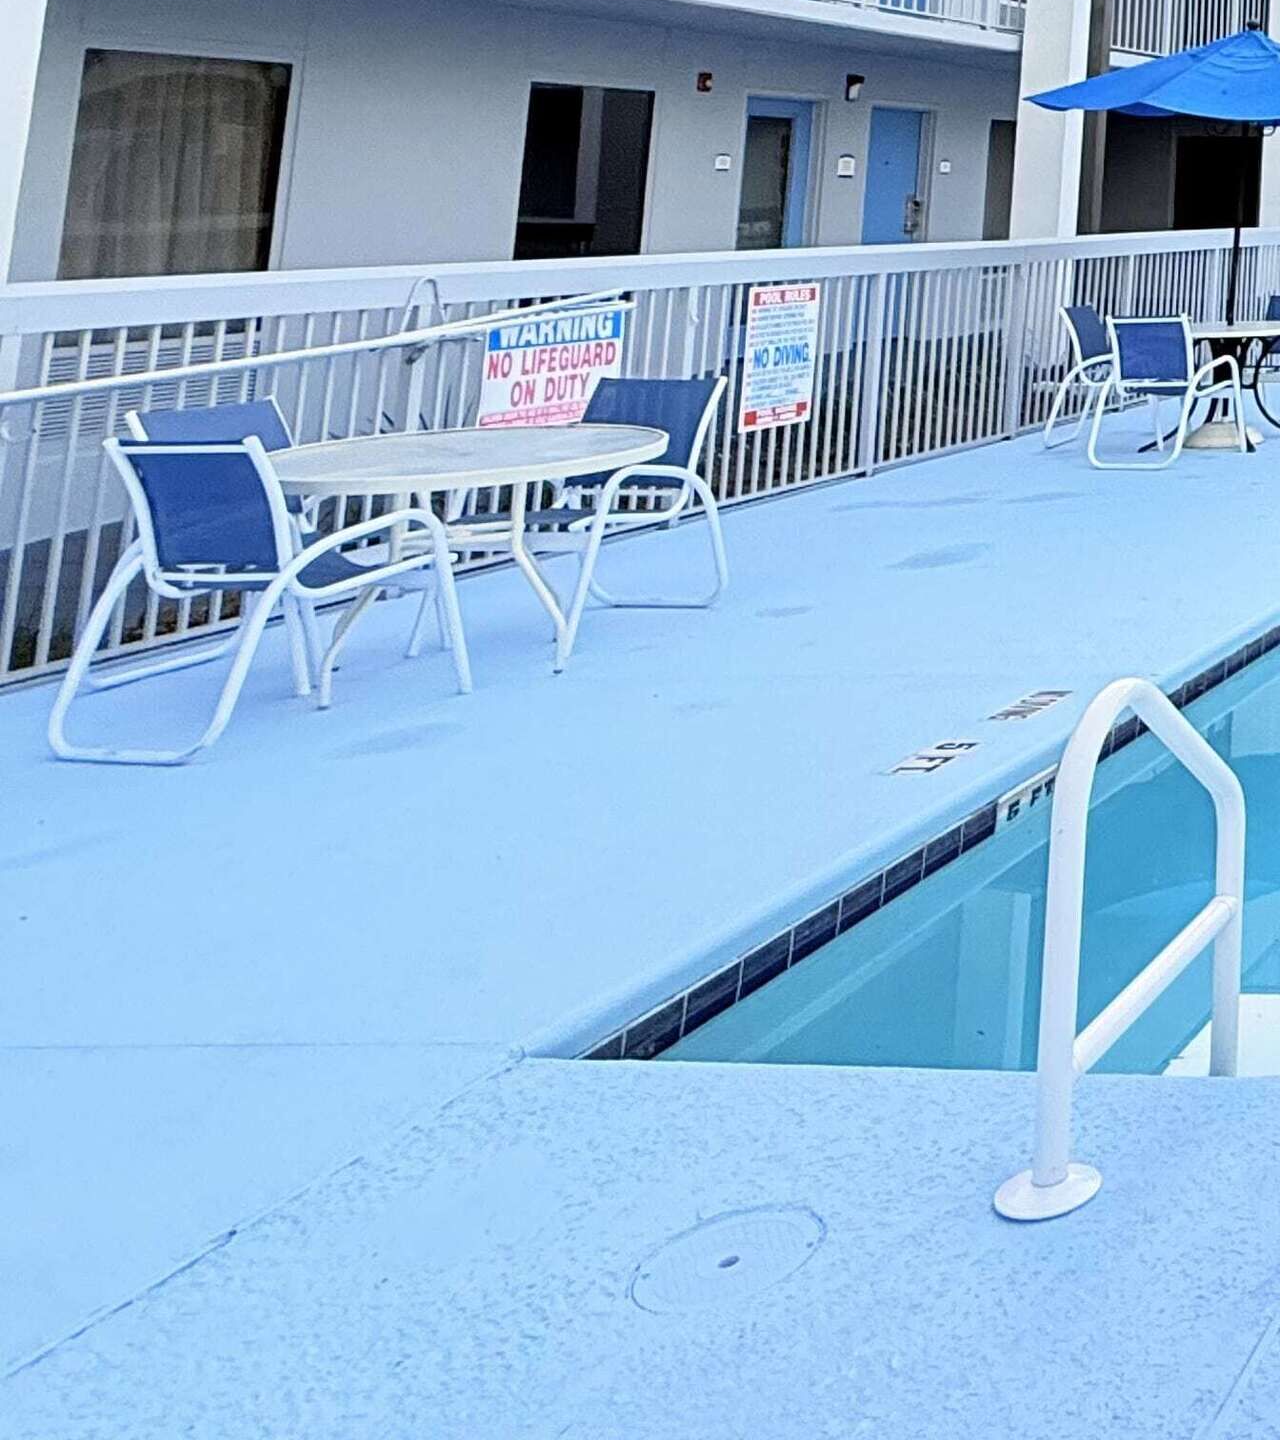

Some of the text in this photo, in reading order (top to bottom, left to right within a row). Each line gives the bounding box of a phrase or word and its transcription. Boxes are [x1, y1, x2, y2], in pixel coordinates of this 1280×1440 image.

[499, 311, 614, 348] WARNING
[488, 342, 617, 380] NO LIFEGUARD
[754, 347, 769, 369] NO
[510, 372, 590, 408] ON DUTY
